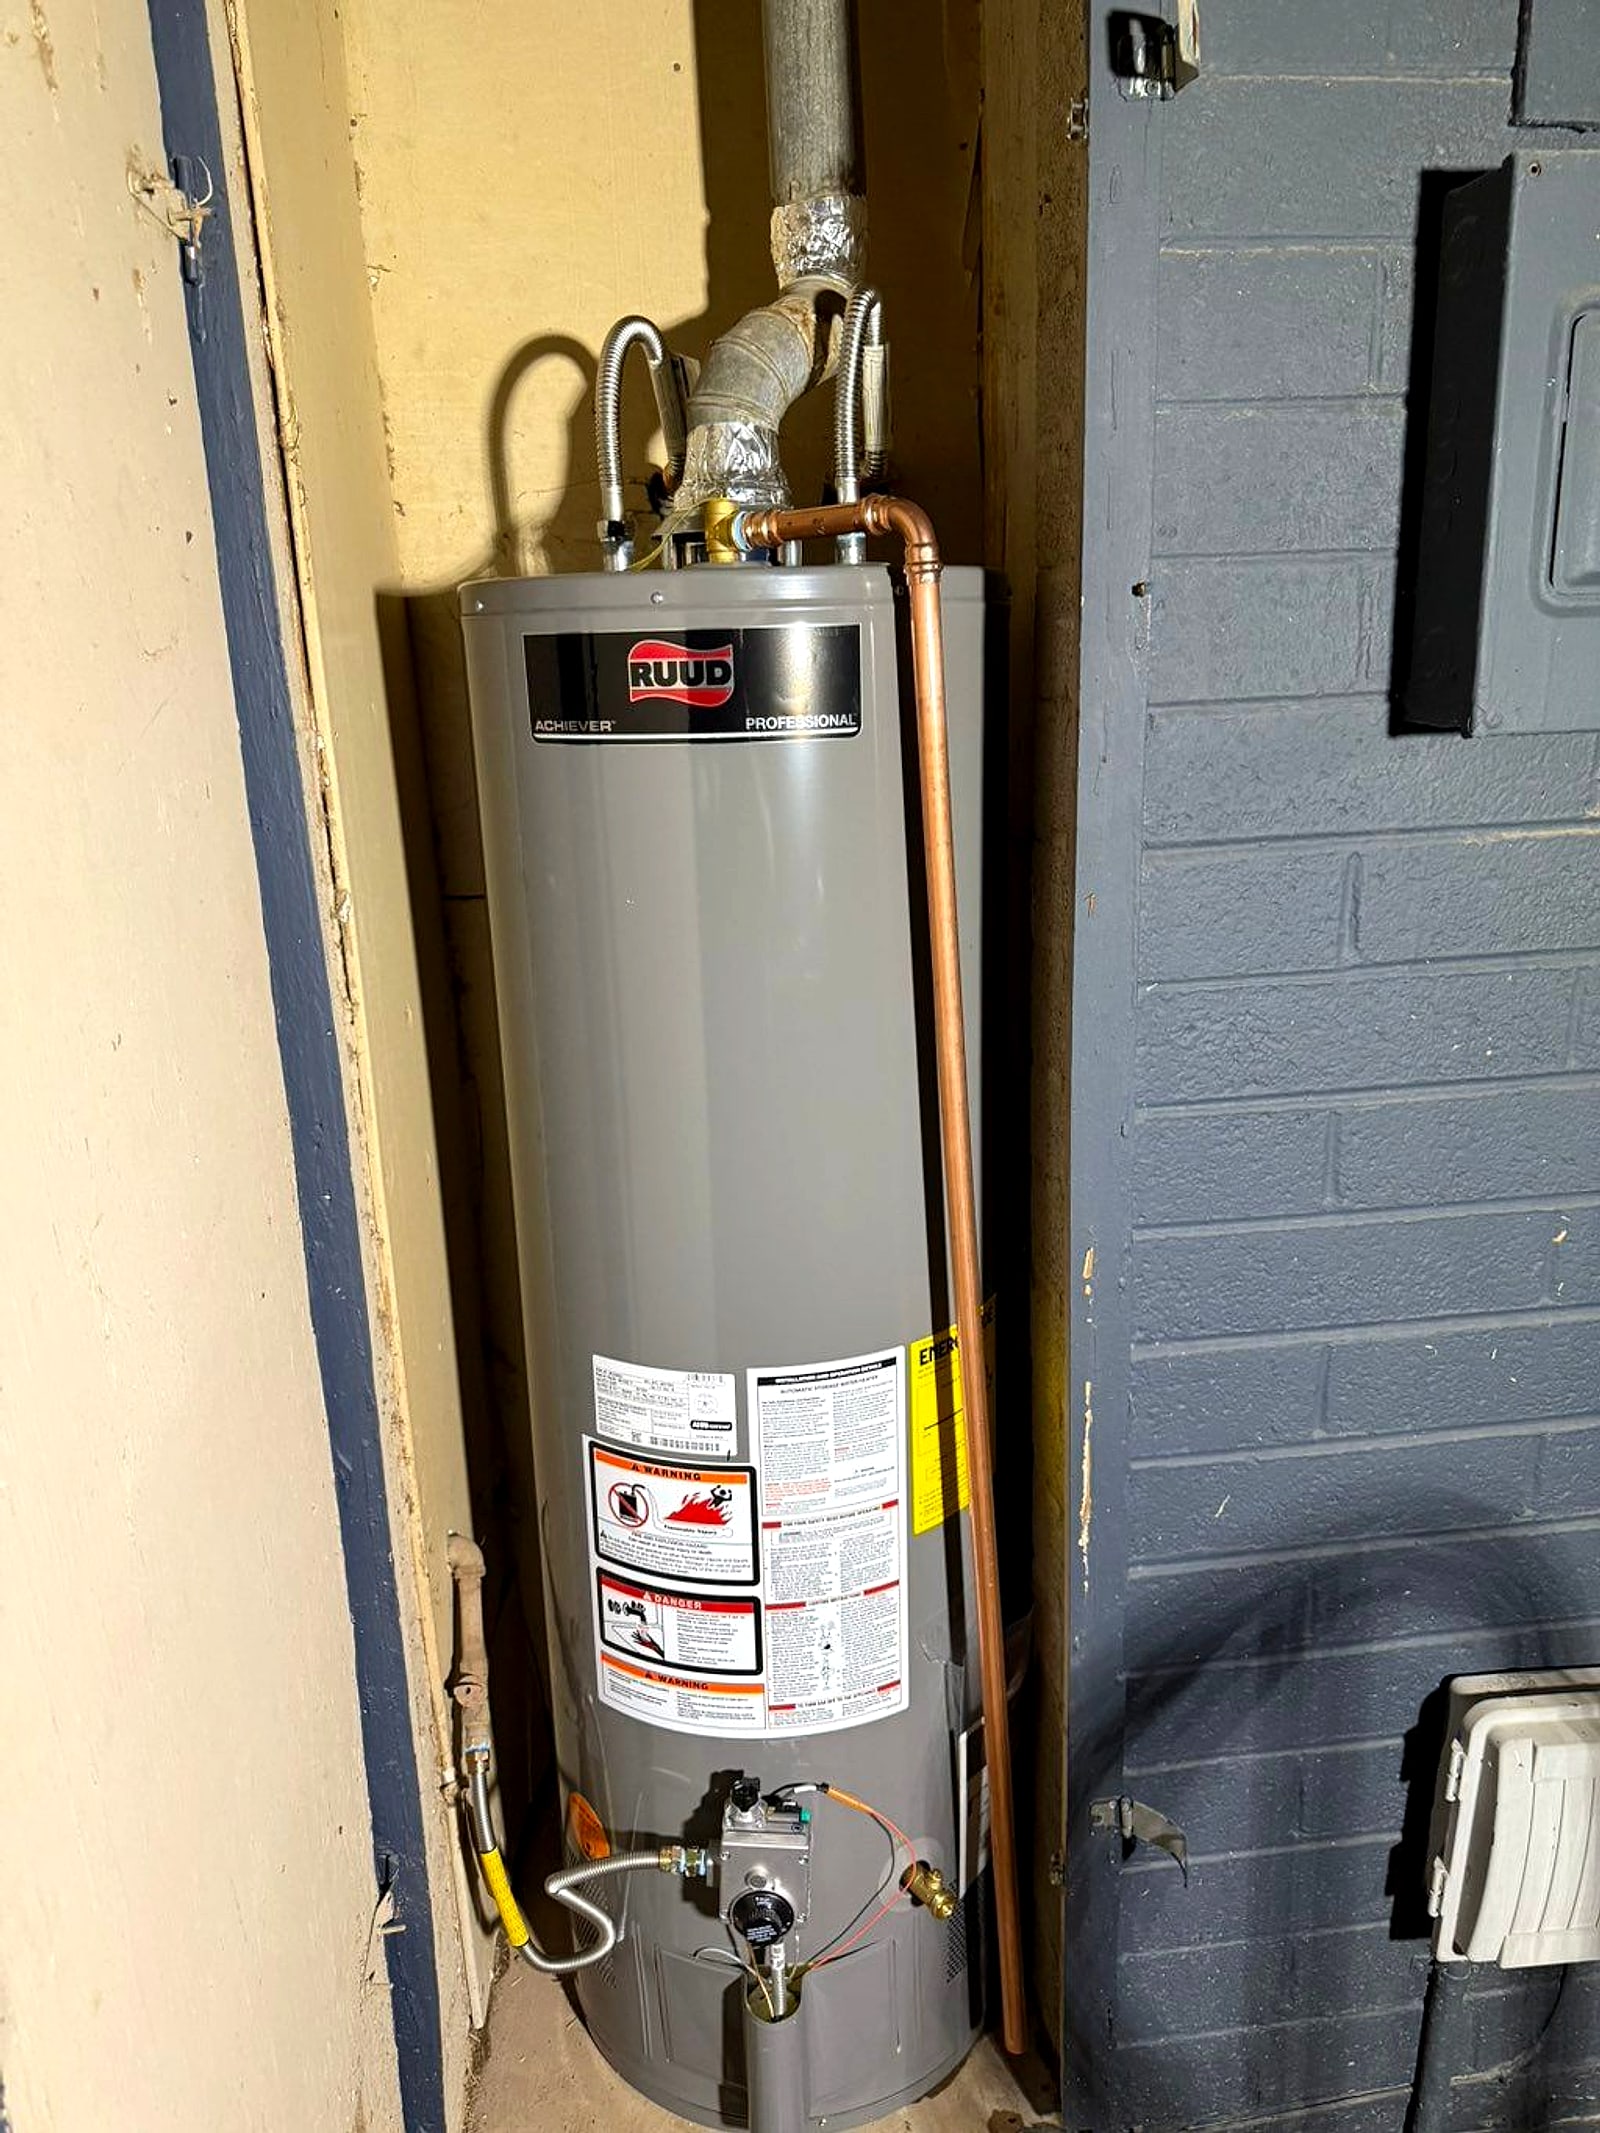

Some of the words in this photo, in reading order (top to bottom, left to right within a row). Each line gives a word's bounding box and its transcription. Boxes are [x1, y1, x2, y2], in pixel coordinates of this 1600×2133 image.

[630, 660, 732, 689] RUUD
[745, 713, 857, 730] PROFESSIONAL
[644, 1465, 701, 1481] WARNING
[653, 1593, 702, 1610] DANGER
[657, 1674, 709, 1691] WARNING
